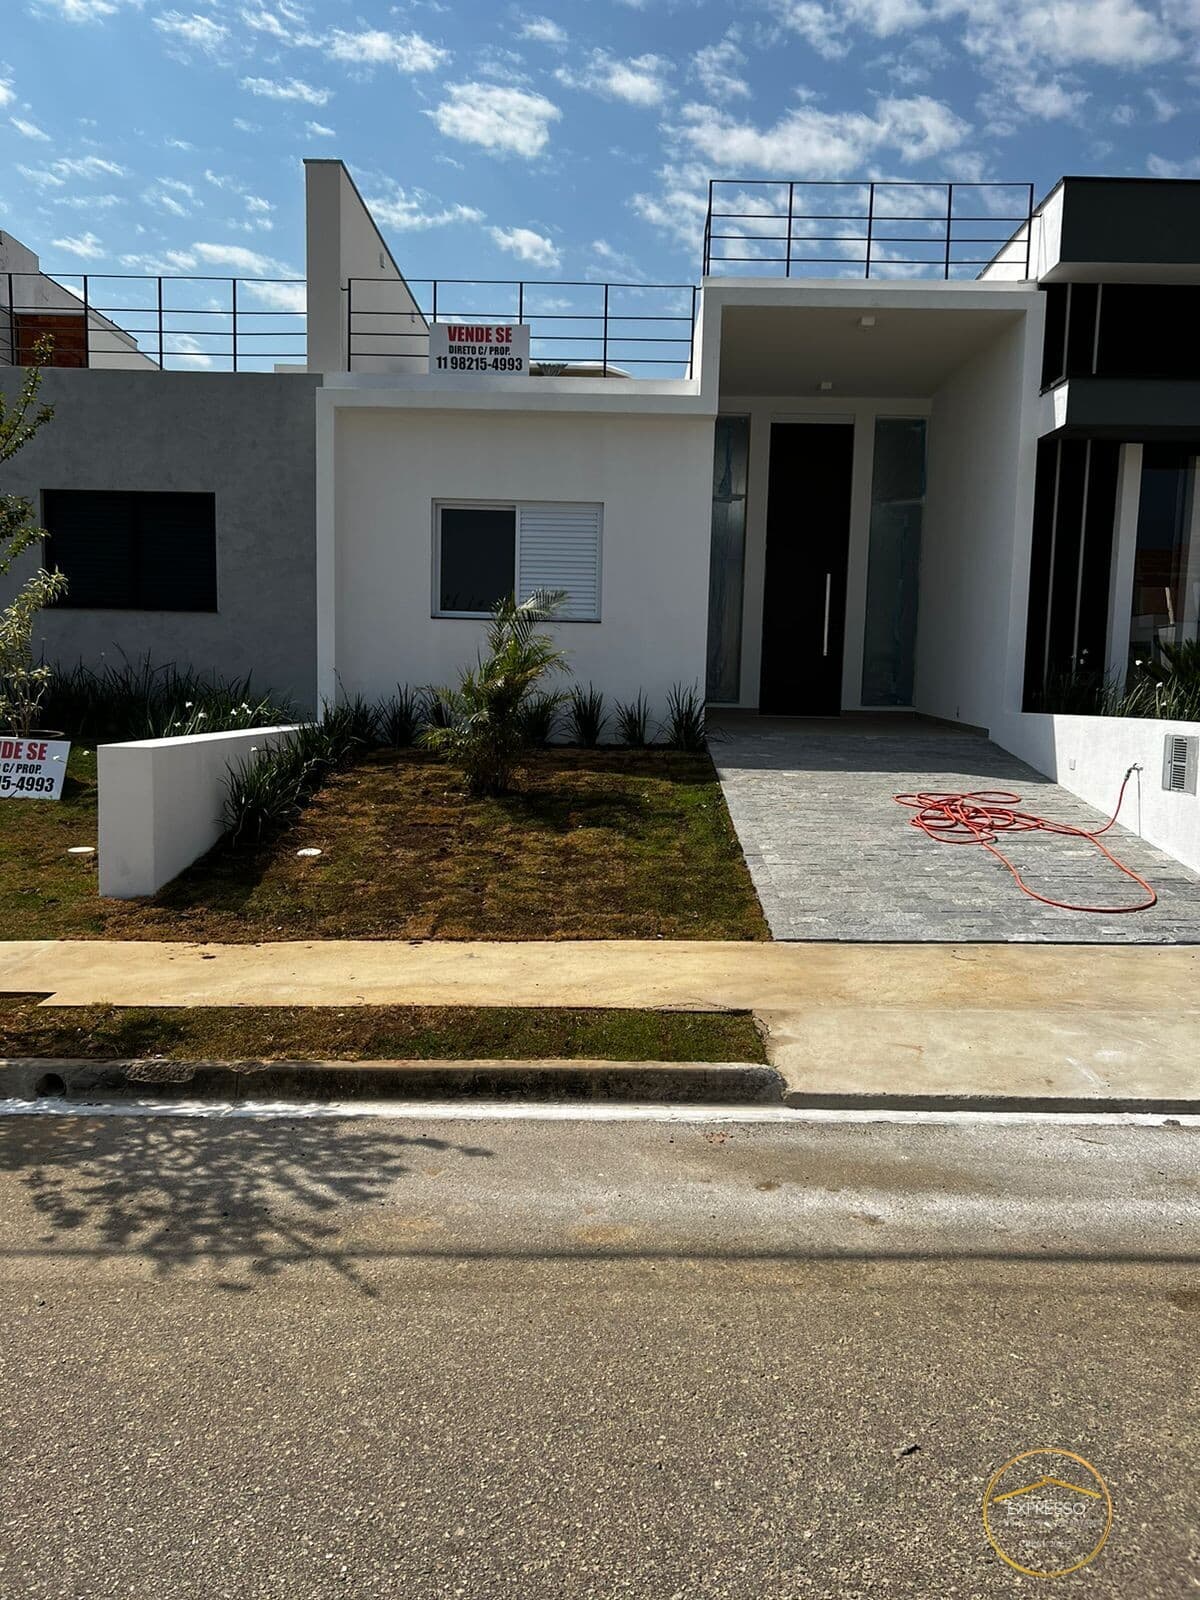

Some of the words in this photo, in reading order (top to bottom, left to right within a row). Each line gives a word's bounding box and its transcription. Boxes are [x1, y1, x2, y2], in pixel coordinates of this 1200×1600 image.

[447, 326, 492, 342] VENDE
[495, 327, 513, 343] SE
[448, 345, 477, 355] DIRETO
[478, 346, 488, 355] C/
[489, 346, 511, 356] PROP.
[436, 356, 448, 369] 11
[450, 357, 523, 371] 98215-4993
[0, 741, 23, 759] DE
[26, 742, 48, 760] SE
[2, 763, 15, 773] C/
[15, 763, 42, 774] PROP.
